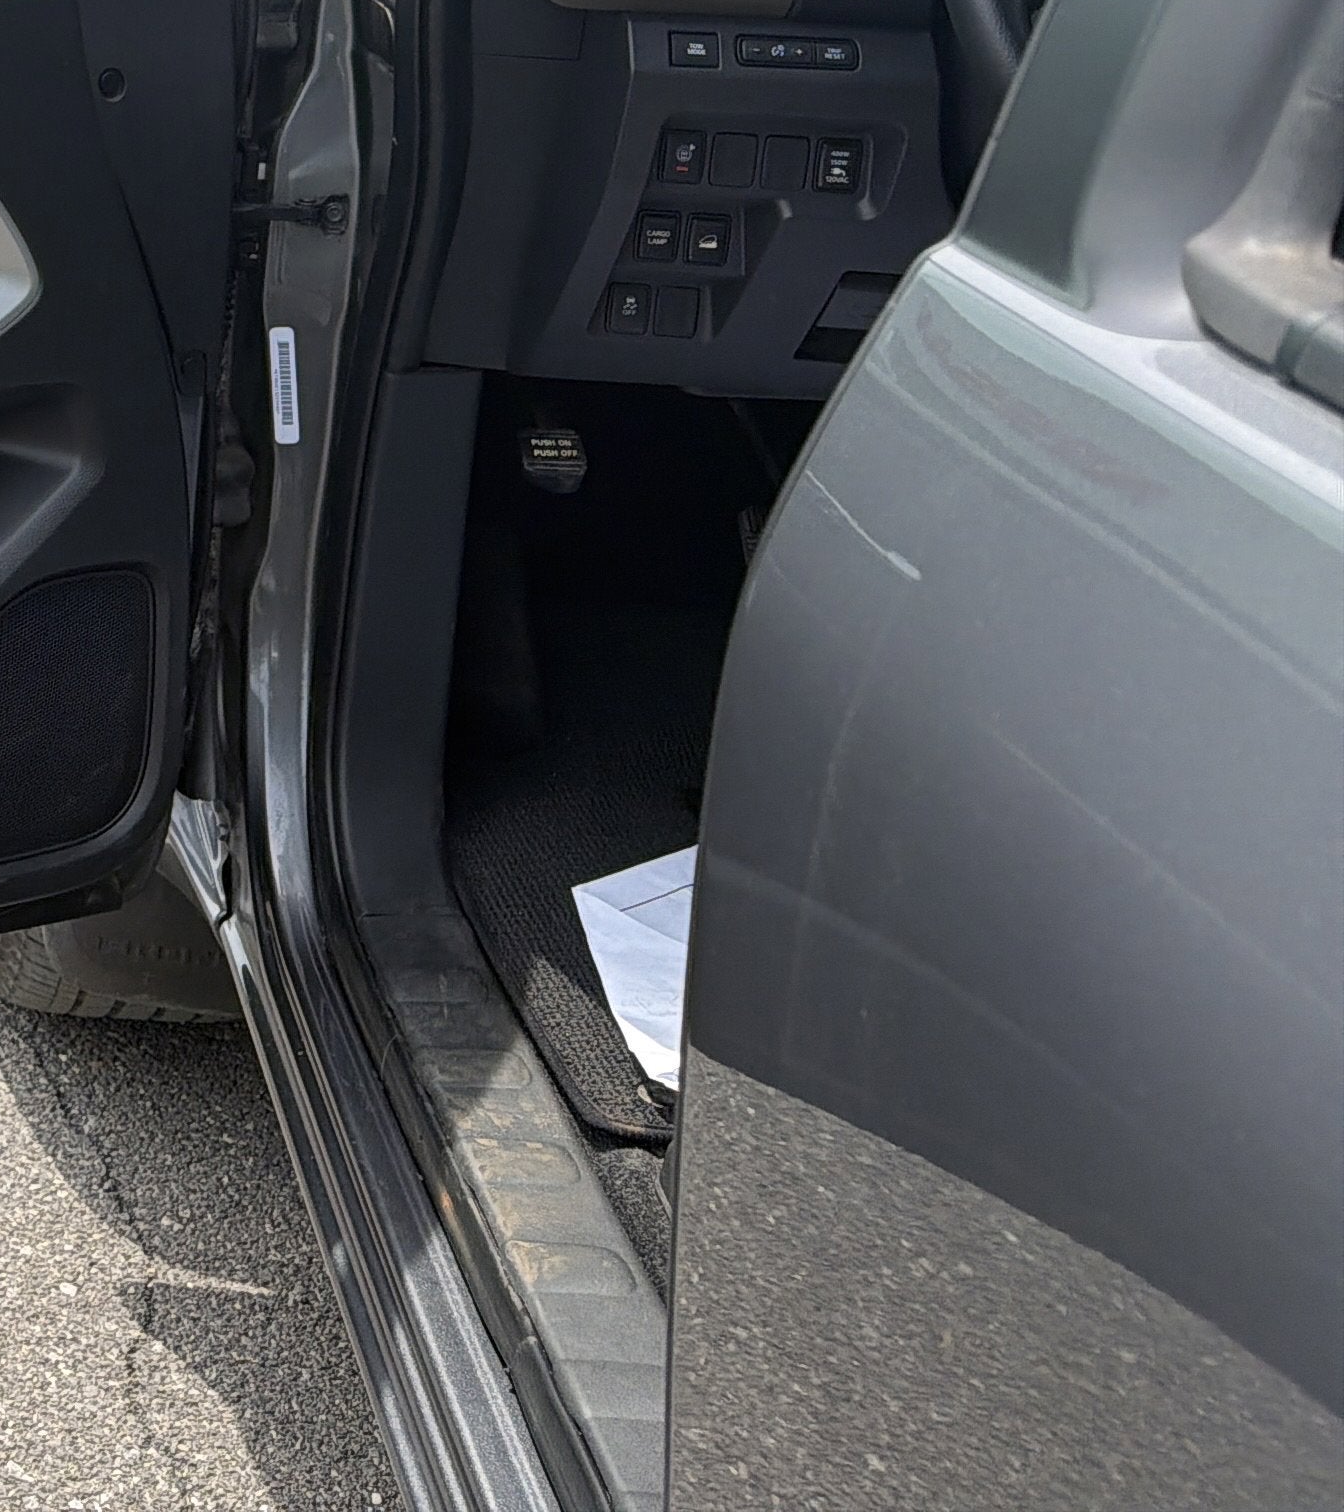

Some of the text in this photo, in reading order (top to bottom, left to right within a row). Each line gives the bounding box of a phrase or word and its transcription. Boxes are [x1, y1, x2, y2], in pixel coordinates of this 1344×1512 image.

[646, 230, 671, 238] CARGO
[531, 439, 572, 447] PUSH ON
[533, 449, 578, 457] PUSH OFF
